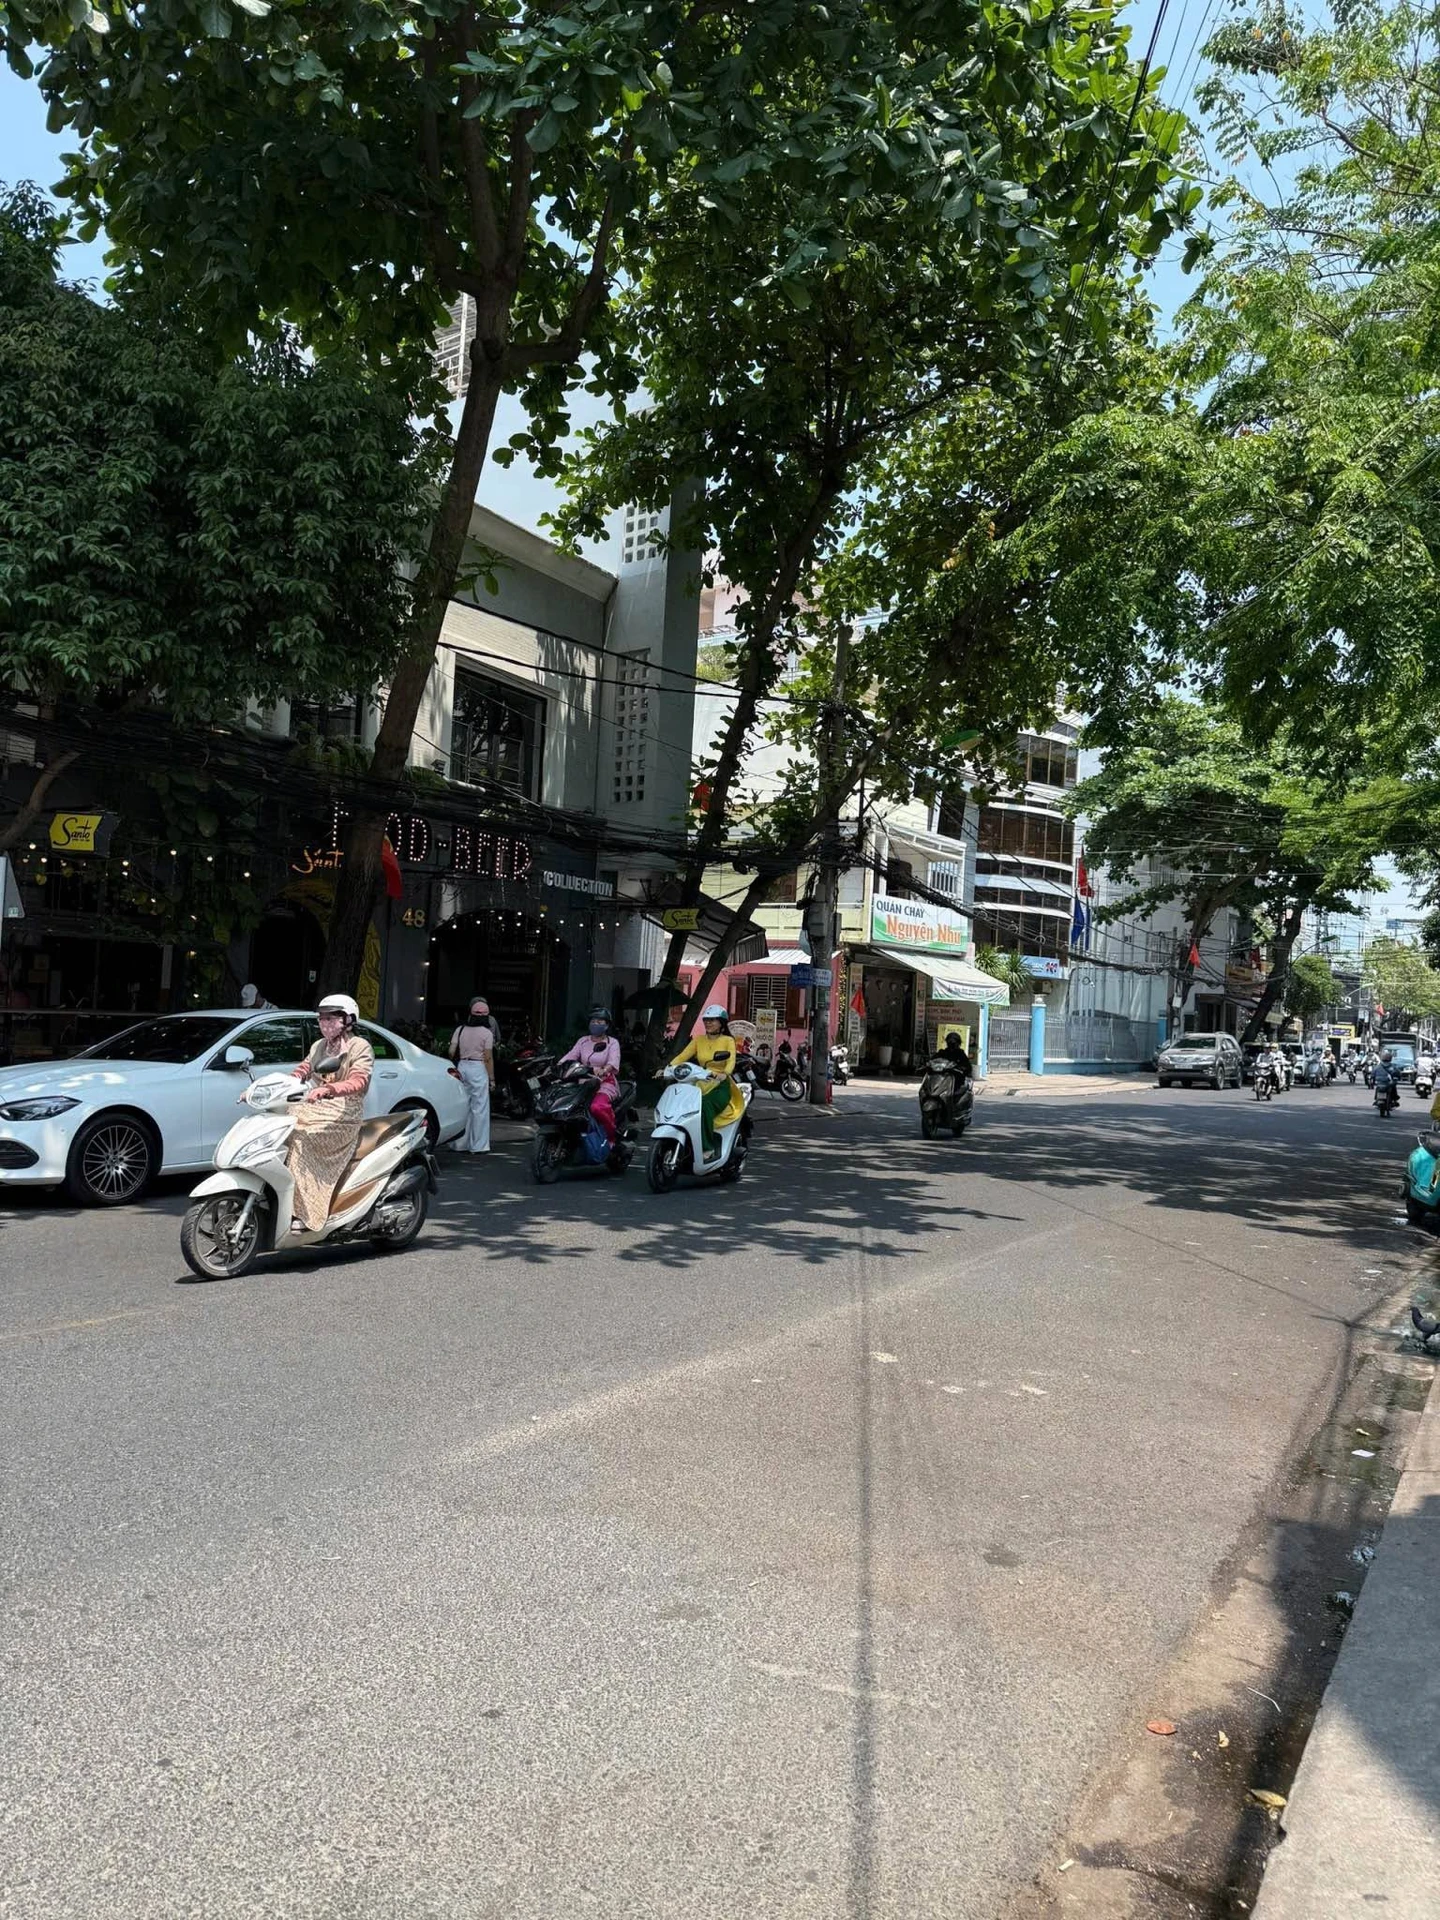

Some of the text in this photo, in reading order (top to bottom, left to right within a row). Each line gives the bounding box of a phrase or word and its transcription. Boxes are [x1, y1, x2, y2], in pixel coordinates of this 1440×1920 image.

[52, 816, 93, 847] Santo
[544, 870, 613, 897] COLLECTION
[402, 907, 426, 928] 48
